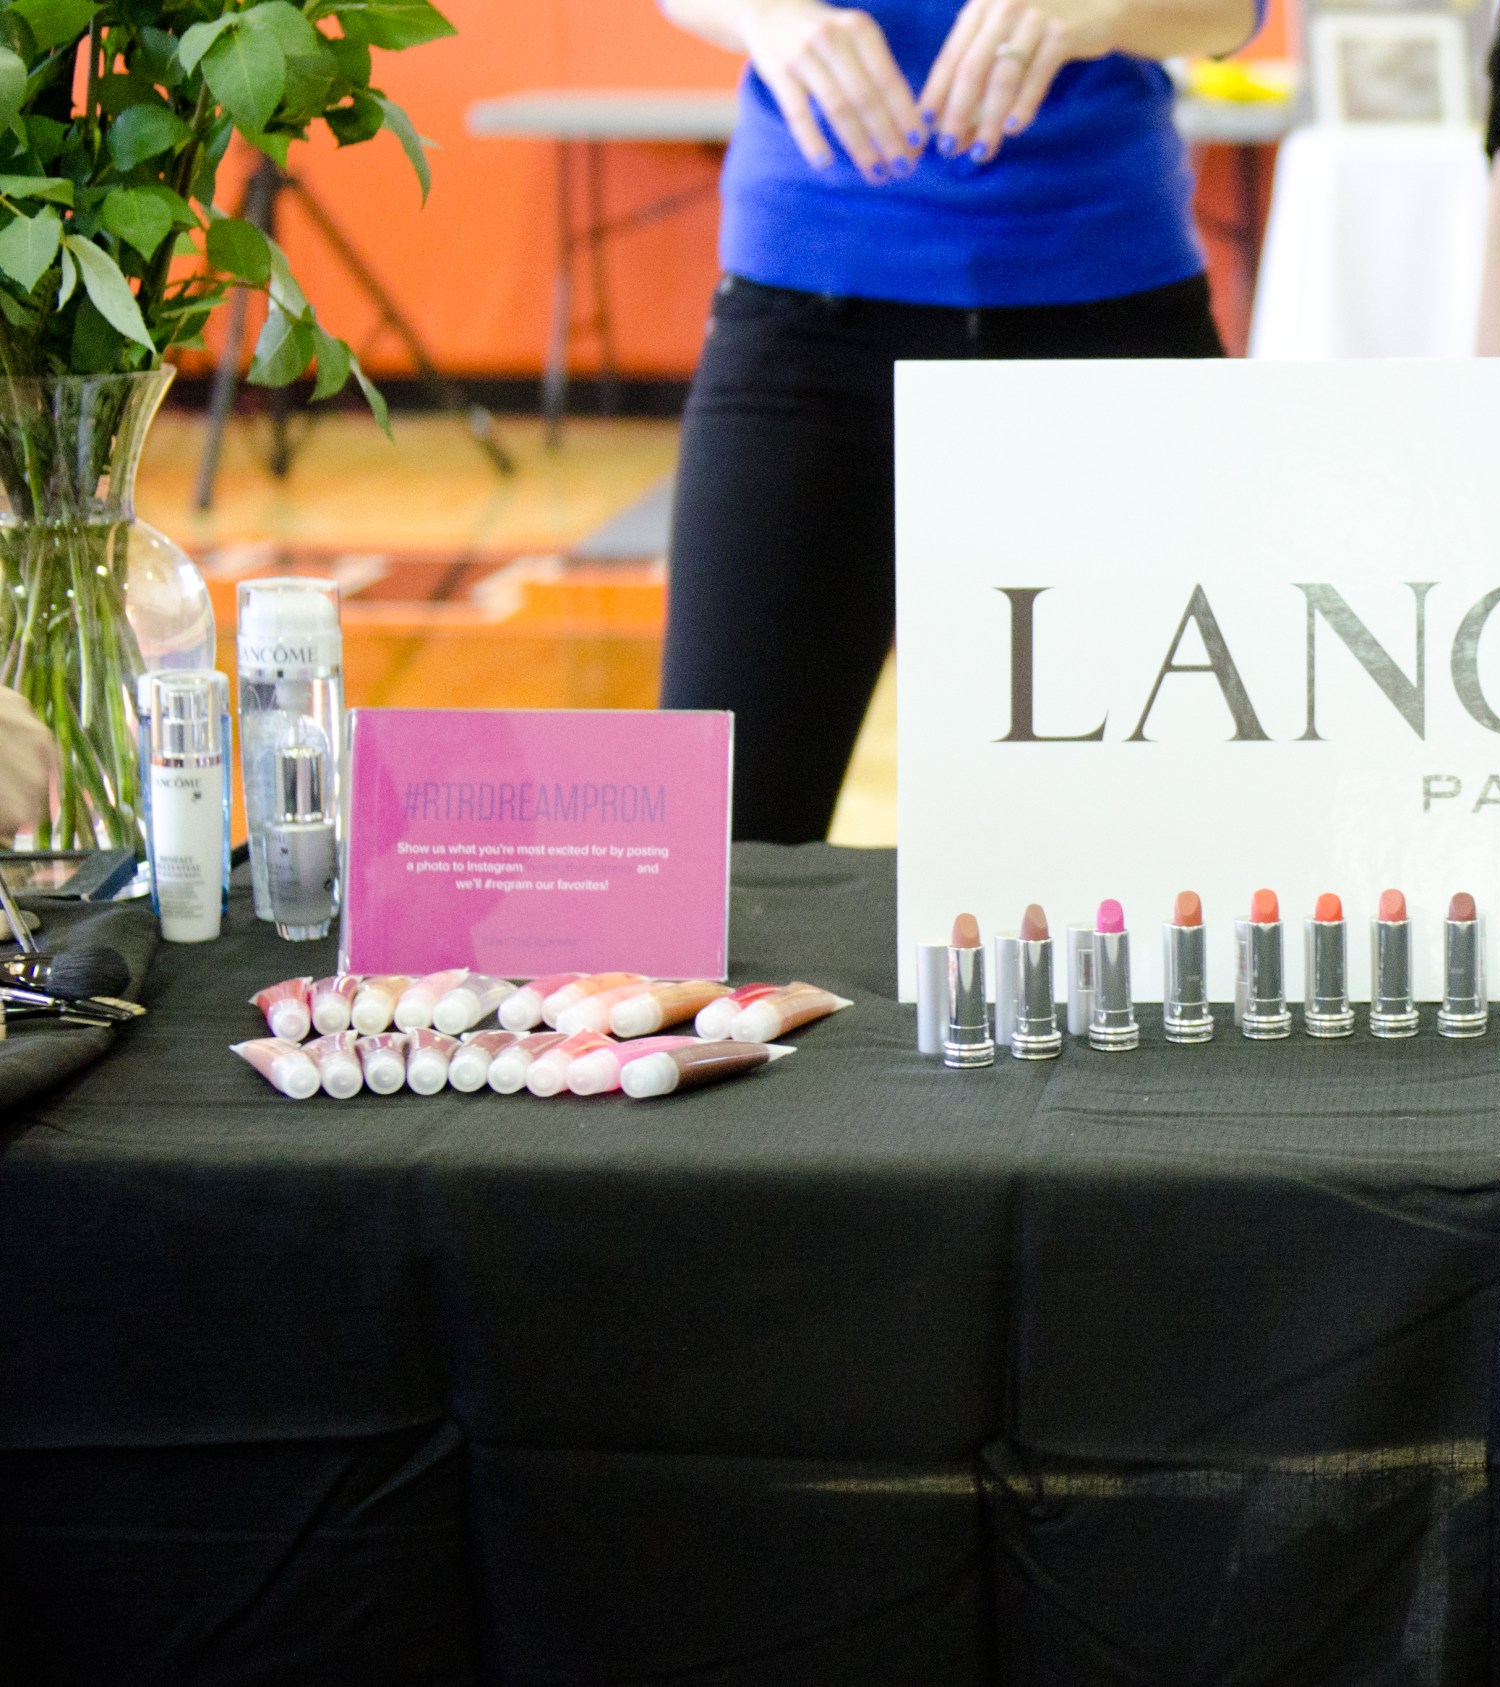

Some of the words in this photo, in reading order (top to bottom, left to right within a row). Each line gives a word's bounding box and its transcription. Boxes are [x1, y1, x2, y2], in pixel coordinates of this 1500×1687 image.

[242, 644, 319, 665] ANCÔME
[403, 782, 666, 823] #RTRDREAMPROM
[397, 841, 429, 855] Show
[432, 845, 446, 855] us
[448, 843, 476, 855] what
[479, 843, 514, 859] you're
[517, 844, 545, 856] most
[548, 843, 589, 857] excited
[591, 843, 606, 857] for
[609, 844, 624, 860] by
[627, 844, 669, 860] posting
[406, 863, 414, 872] a
[416, 860, 450, 874] photo
[452, 861, 464, 872] to
[467, 861, 523, 875] Instagram
[636, 863, 659, 875] and
[456, 879, 482, 891] we'll
[484, 880, 533, 893] #regram
[535, 882, 554, 891] our
[557, 880, 609, 892] favorites!
